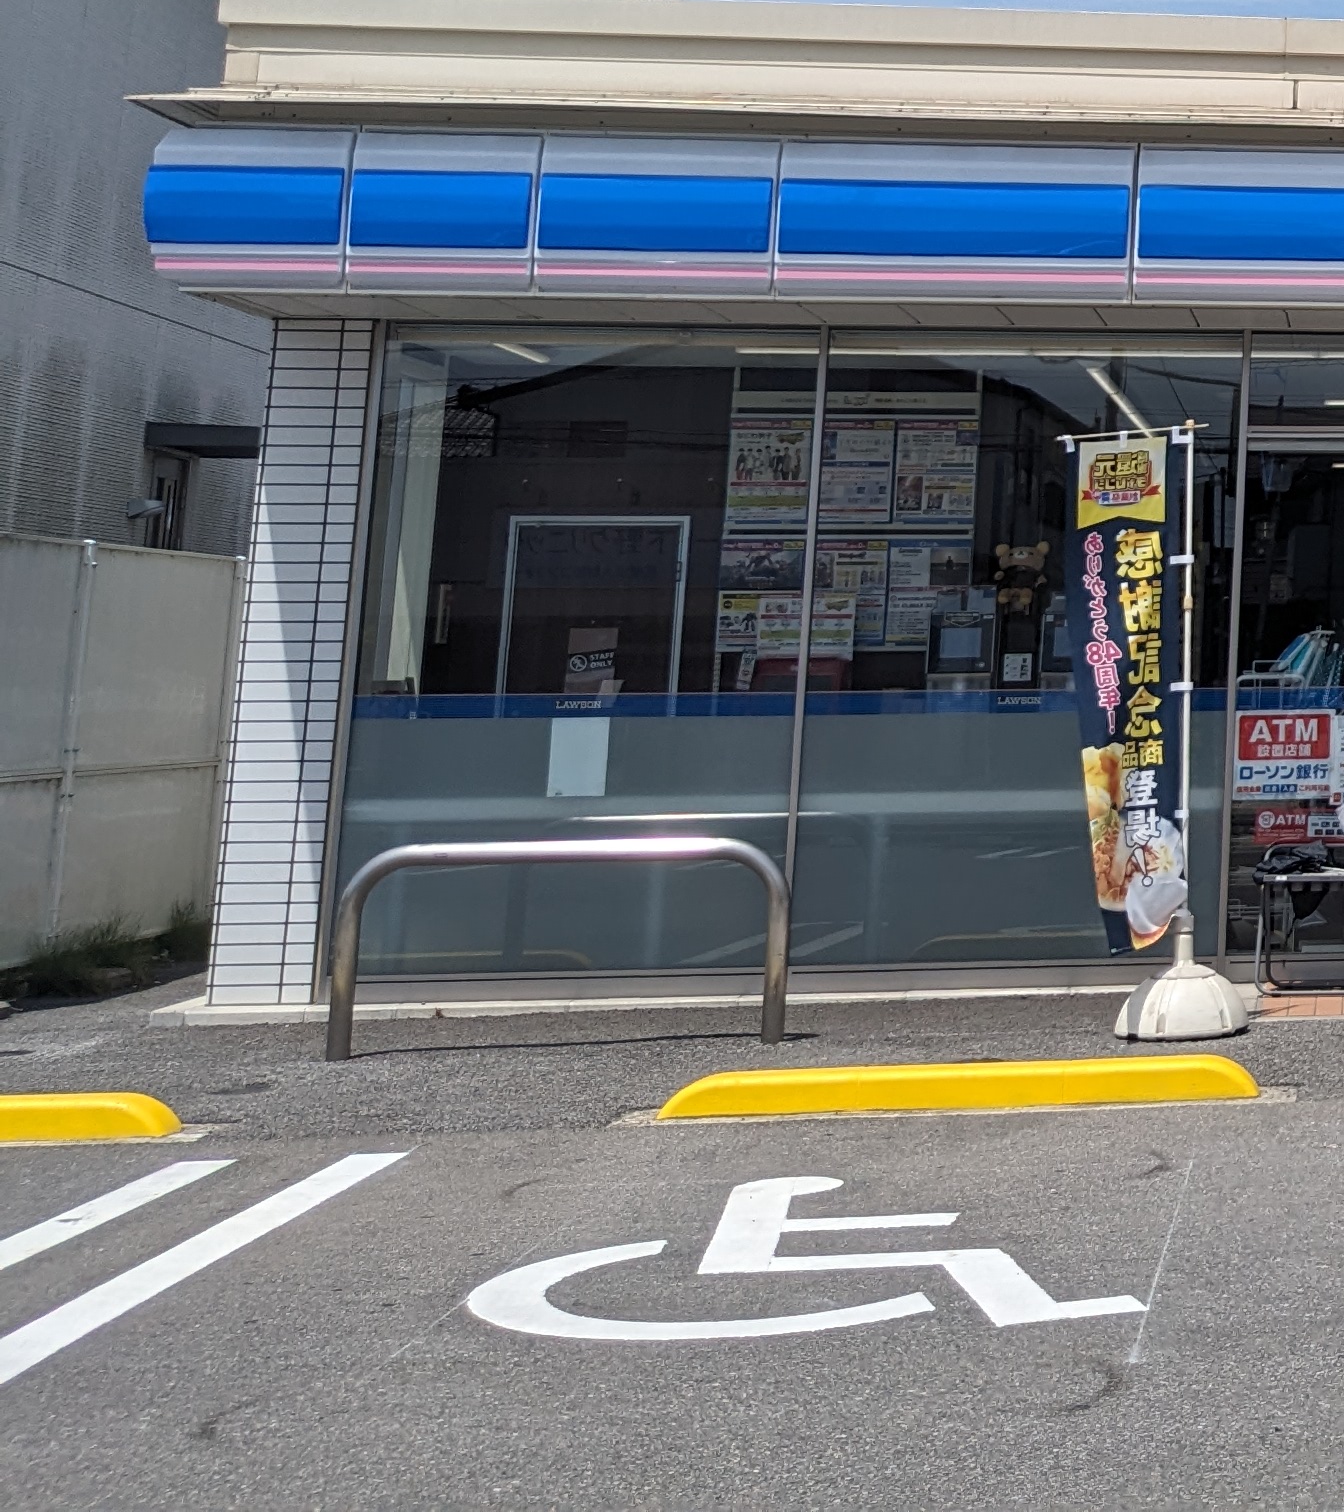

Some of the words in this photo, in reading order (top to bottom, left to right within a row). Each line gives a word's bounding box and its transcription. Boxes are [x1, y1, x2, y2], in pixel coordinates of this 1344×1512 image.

[589, 651, 615, 662] STAFF
[590, 659, 614, 670] ONLY
[555, 699, 602, 709] LAWSON
[997, 695, 1042, 705] LAWSON
[1249, 718, 1320, 743] ATM
[1256, 743, 1312, 758] 設置店舗
[1239, 763, 1330, 781] ローソン銀行
[1275, 814, 1307, 826] ATM
